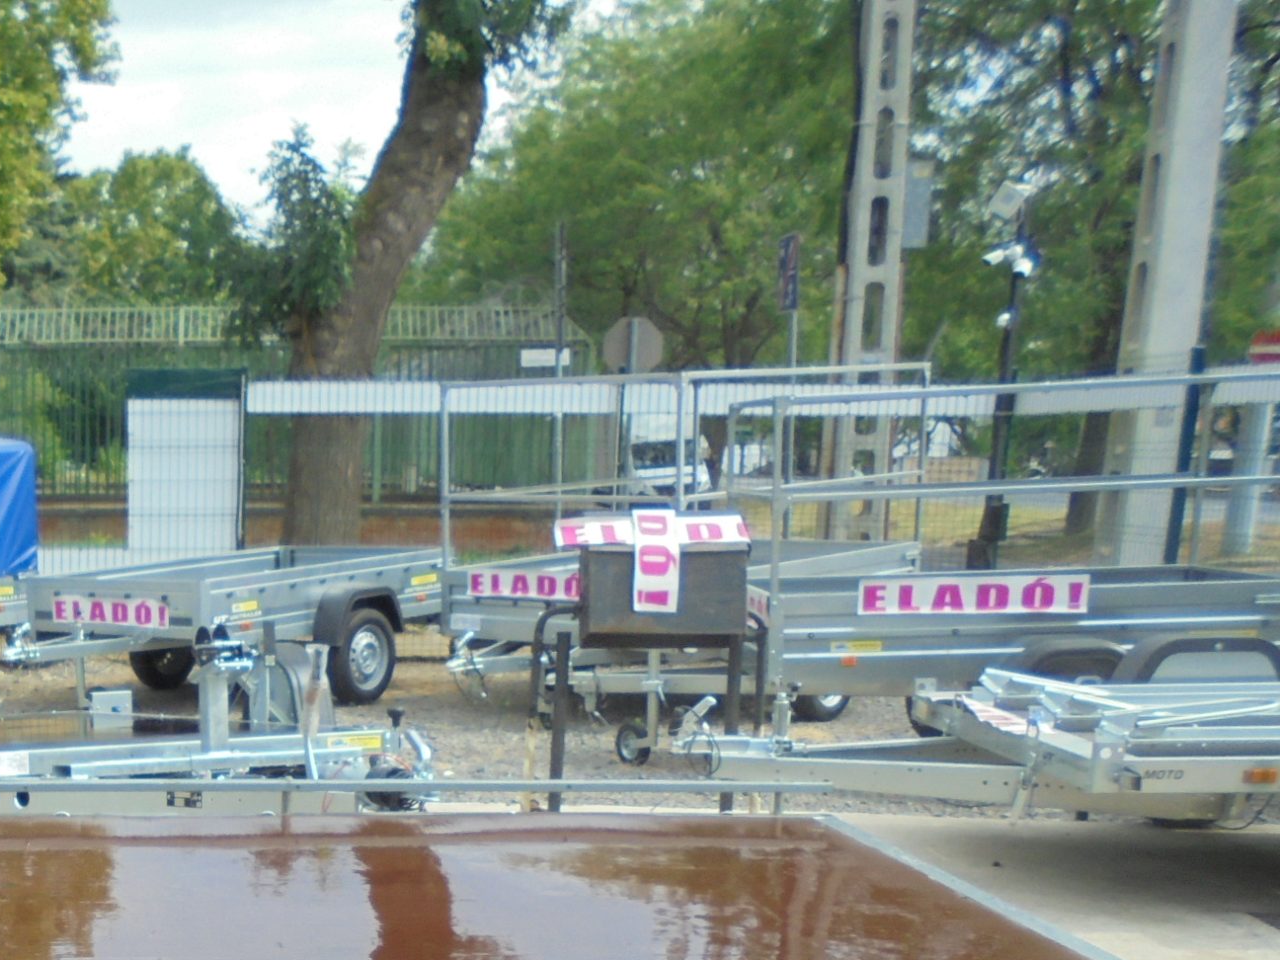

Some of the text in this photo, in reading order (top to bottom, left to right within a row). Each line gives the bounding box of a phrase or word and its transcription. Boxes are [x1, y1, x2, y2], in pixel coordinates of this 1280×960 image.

[471, 572, 581, 597] ELADÓ
[862, 577, 1084, 611] ELADÓ!
[54, 600, 169, 627] ELADÓ!
[1143, 769, 1185, 780] MOTO
